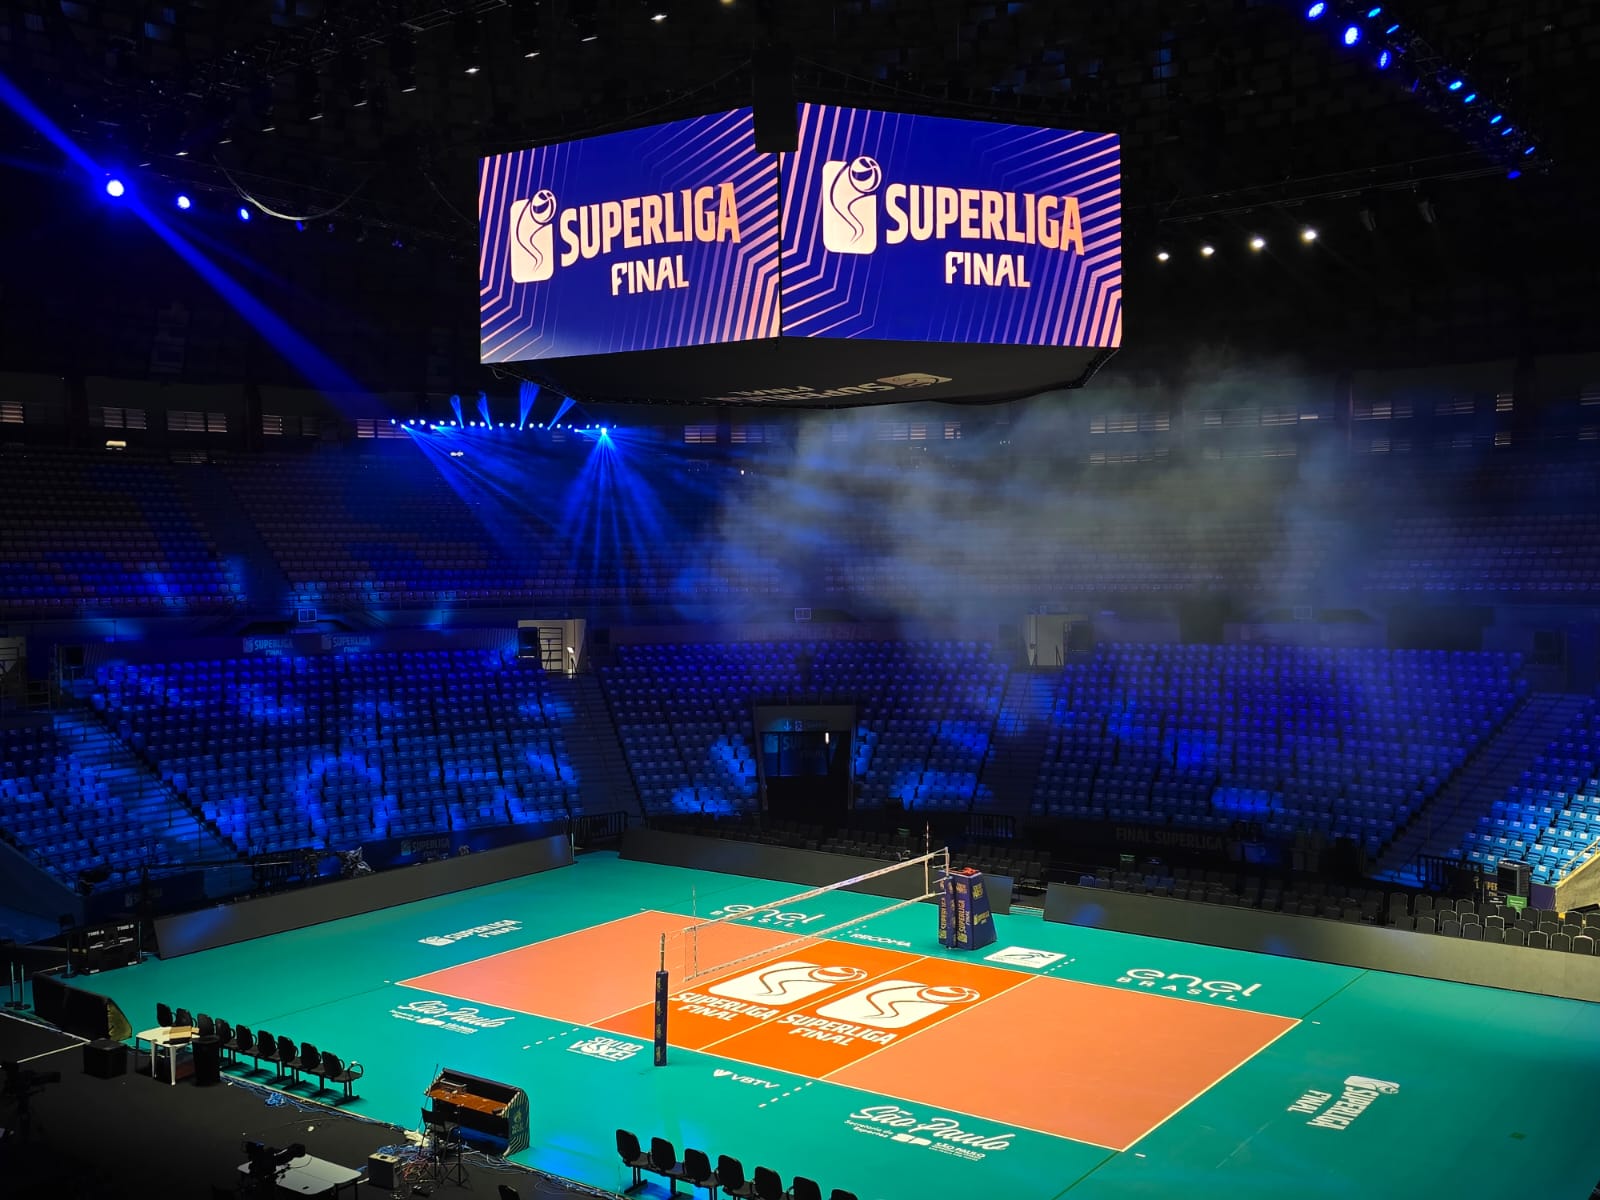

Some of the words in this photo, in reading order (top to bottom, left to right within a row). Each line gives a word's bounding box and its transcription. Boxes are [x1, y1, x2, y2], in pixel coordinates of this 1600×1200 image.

[560, 182, 741, 267] SUPERLIGA
[885, 183, 1085, 255] SUPERLIGA
[611, 255, 690, 296] FINAL
[945, 251, 1031, 288] FINAL
[254, 639, 294, 651] SUPERLIGA
[1115, 827, 1152, 842] FINAL
[1154, 830, 1223, 850] SUPERLIGA
[709, 910, 794, 928] BASIL
[723, 904, 825, 924] enel
[957, 899, 967, 934] SUPERLIGA
[443, 919, 523, 941] SUPERLIGA
[1116, 976, 1238, 1002] BRASIL
[1126, 968, 1262, 997] enel
[397, 1000, 448, 1014] São
[433, 1007, 516, 1028] Paulo
[668, 992, 780, 1020] SUPERLIGA
[677, 1004, 740, 1021] FINAL
[777, 1013, 899, 1046] SUPERLIGA
[787, 1026, 856, 1047] FINAL
[731, 1074, 781, 1089] VBTV
[1287, 1089, 1333, 1114] FINAL
[1306, 1086, 1380, 1130] SUPERLIGA
[850, 1106, 917, 1127] São
[908, 1118, 1016, 1151] Paulo
